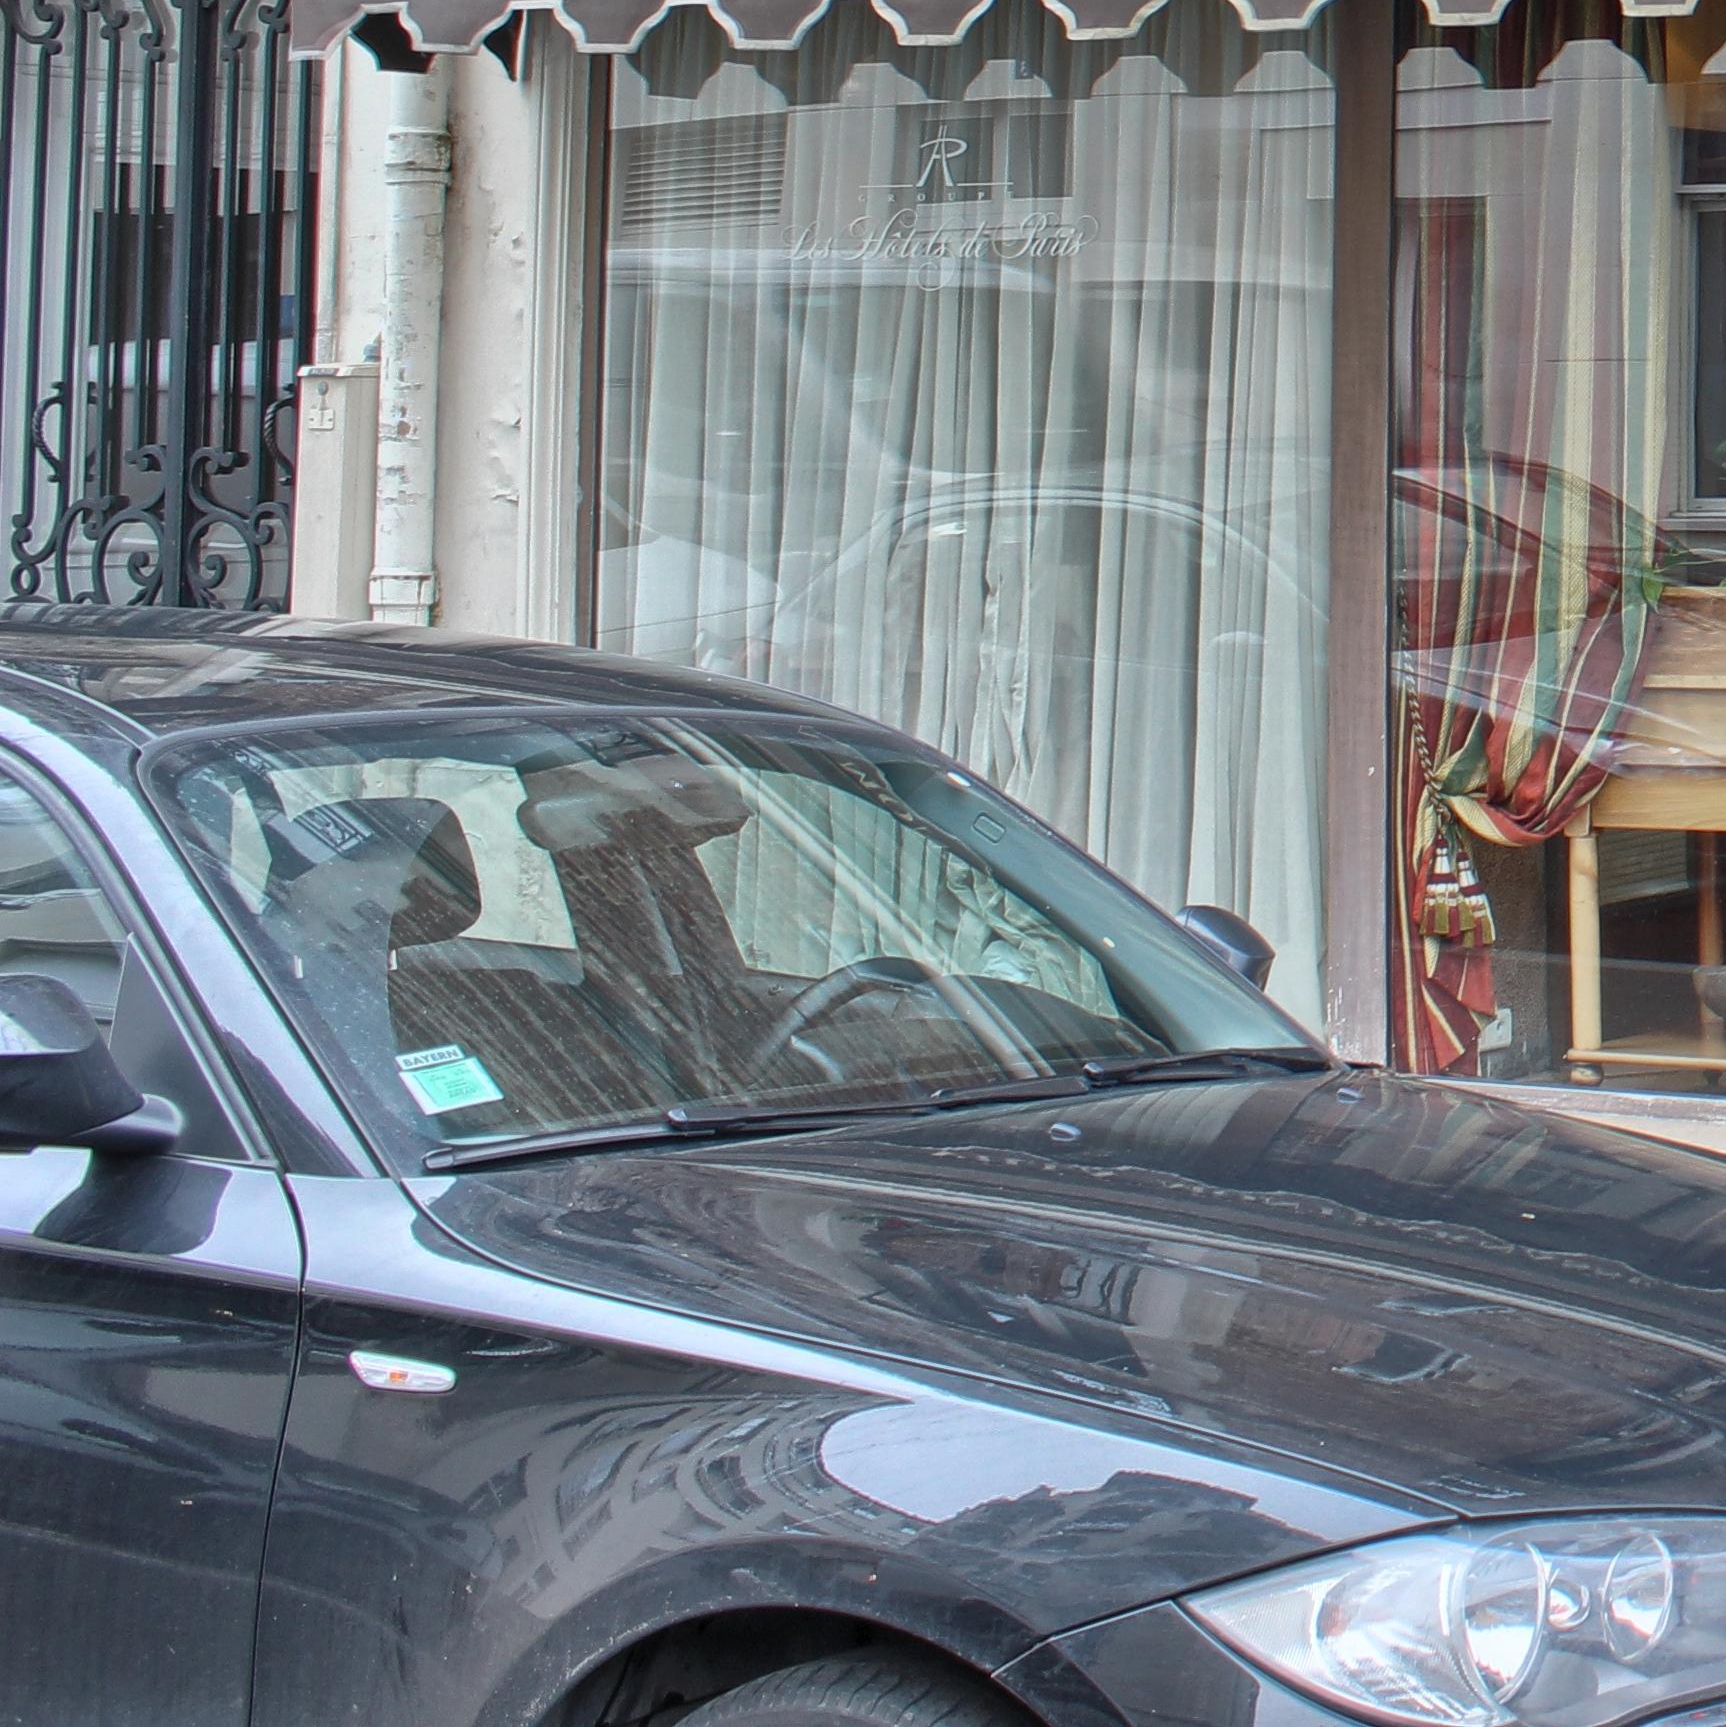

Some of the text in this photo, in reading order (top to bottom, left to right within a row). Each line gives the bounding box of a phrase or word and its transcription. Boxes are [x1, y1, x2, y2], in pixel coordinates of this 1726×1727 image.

[858, 191, 1015, 203] GROUPE
[781, 208, 1099, 290] Les Hôtels de Paris
[402, 1049, 459, 1067] BAYERN
